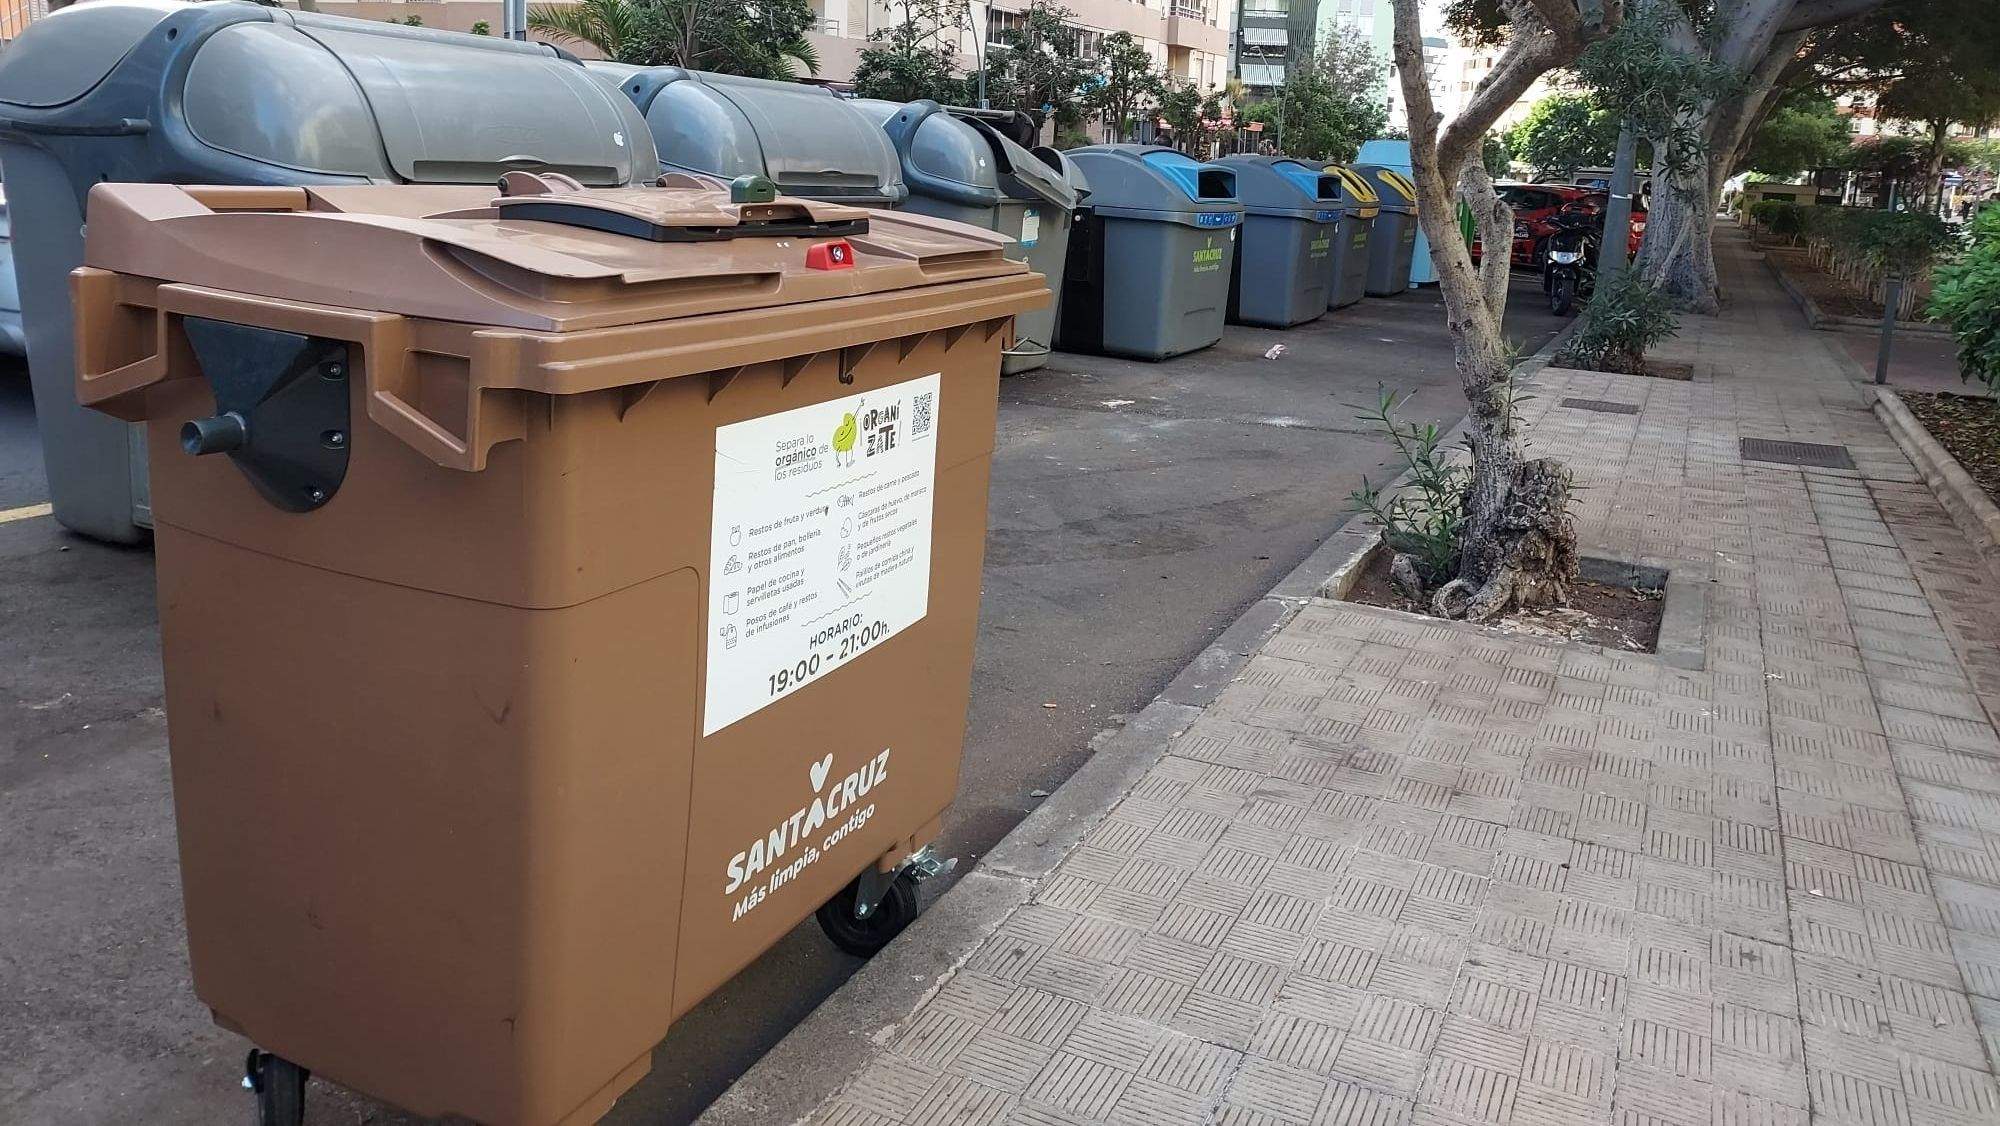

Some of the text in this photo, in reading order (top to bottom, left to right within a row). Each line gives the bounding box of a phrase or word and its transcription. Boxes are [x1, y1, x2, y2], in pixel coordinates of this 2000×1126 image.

[776, 434, 814, 453] Separa lo
[866, 425, 896, 457] ZATE
[775, 443, 829, 467] orgánico de
[775, 459, 823, 482] los residuos
[749, 505, 829, 537] Restos de fruta y verdur
[748, 547, 772, 560] Restos
[773, 543, 782, 552] de
[754, 557, 772, 569] otros
[774, 546, 805, 562] alimentos
[747, 581, 766, 595] Papel
[768, 579, 776, 587] de
[779, 570, 799, 583] cocina
[747, 579, 804, 606] servilletas usadas
[746, 613, 766, 627] Posos
[769, 609, 777, 617] de
[779, 602, 792, 613] café
[799, 592, 818, 605] restos
[746, 614, 789, 638] de infusiones
[809, 613, 863, 650] HORARIO:
[769, 653, 820, 696] 19:00
[839, 620, 890, 660] 21:00h.
[732, 804, 875, 922] Más limpia, contigo
